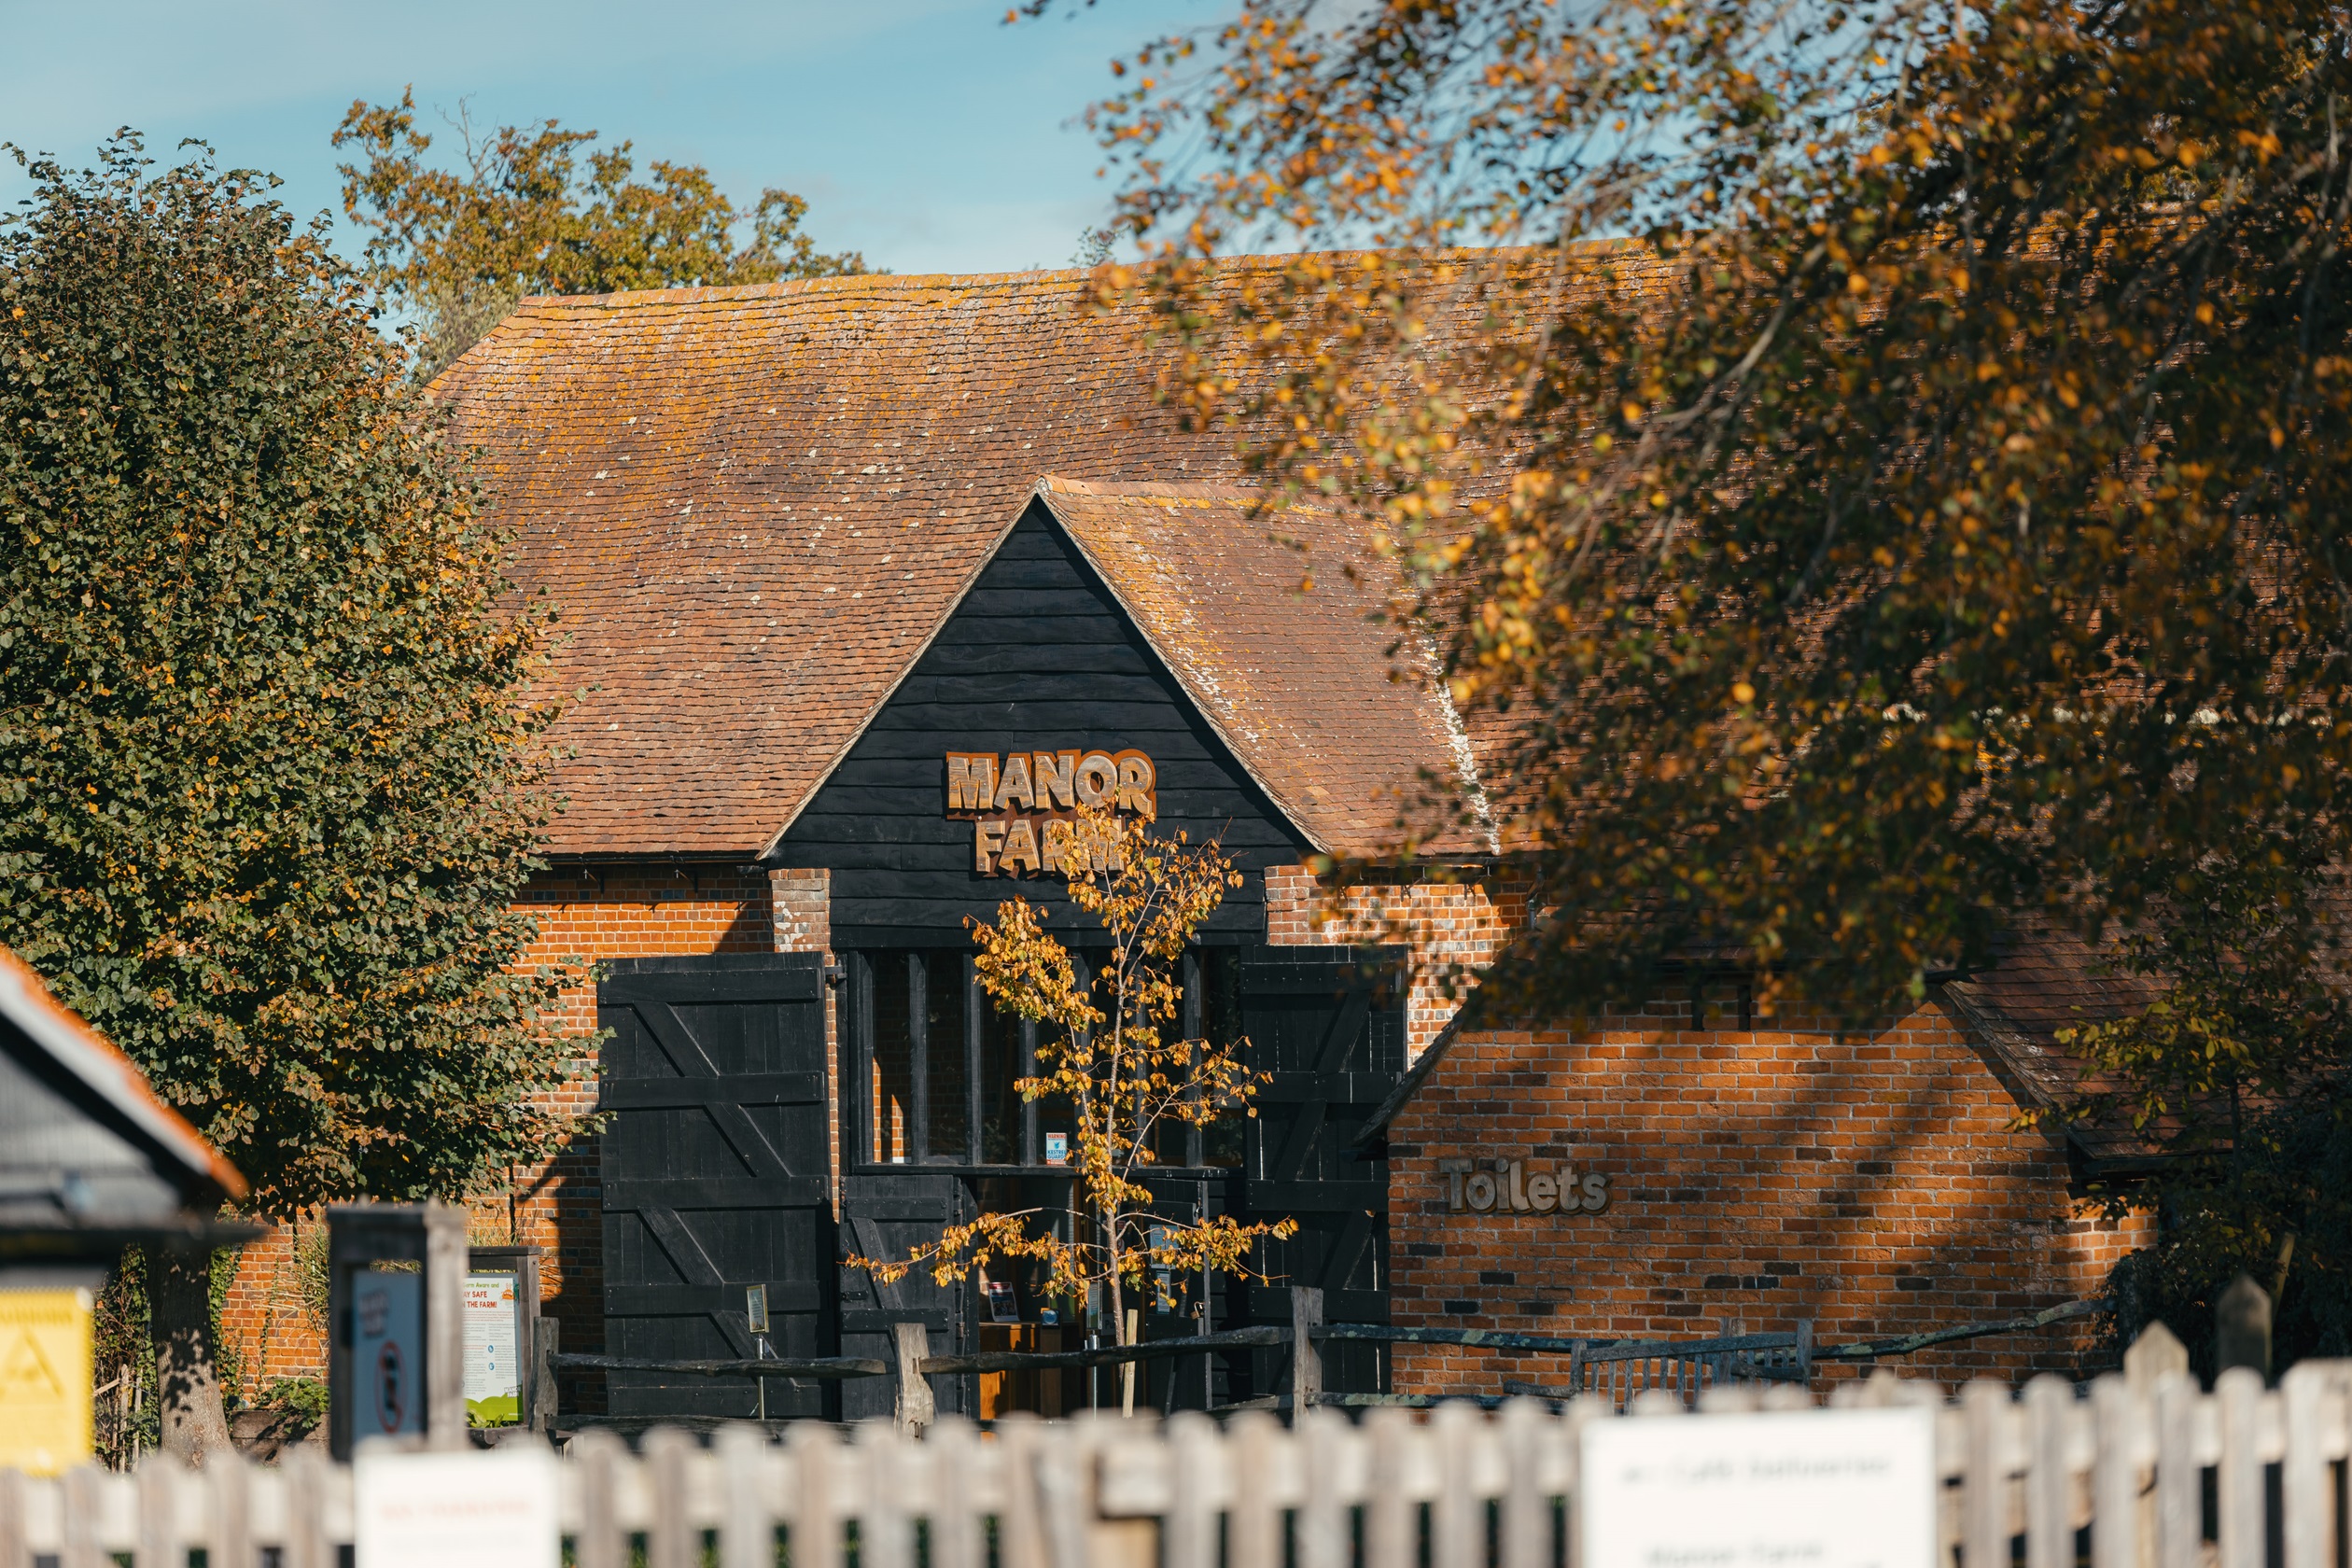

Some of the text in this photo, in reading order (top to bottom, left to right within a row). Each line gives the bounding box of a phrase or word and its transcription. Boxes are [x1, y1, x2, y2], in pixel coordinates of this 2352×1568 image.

[947, 752, 1155, 813] MANOR
[1438, 1157, 1608, 1211] Toilets
[467, 1300, 479, 1309] THE
[479, 1300, 497, 1309] FARM!
